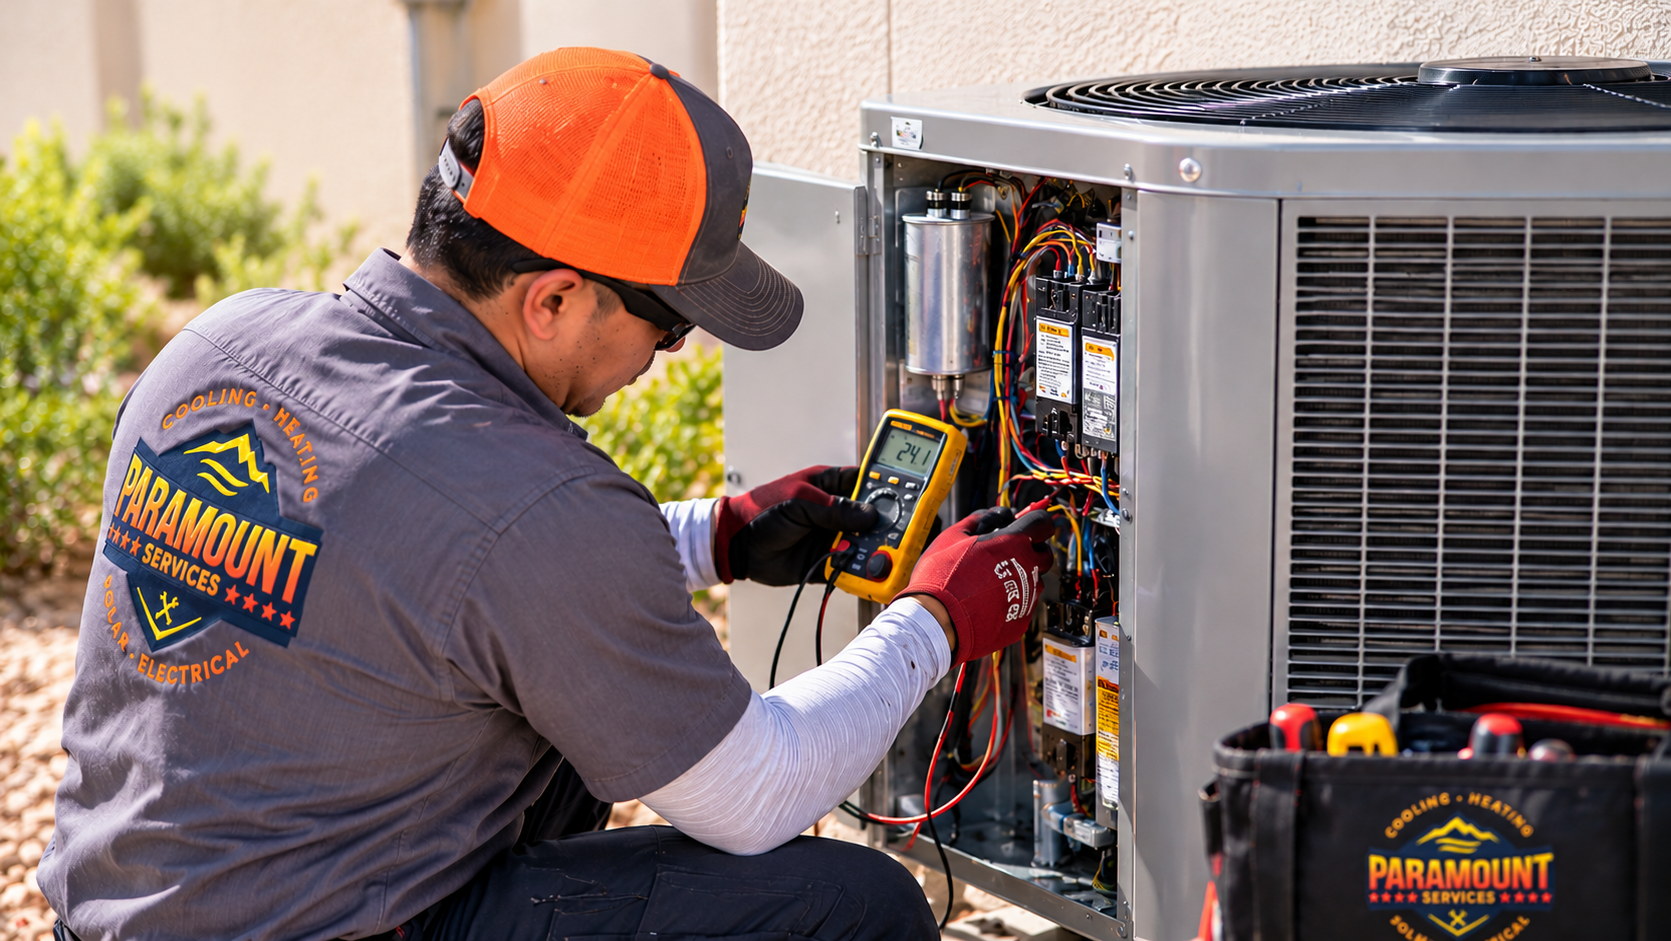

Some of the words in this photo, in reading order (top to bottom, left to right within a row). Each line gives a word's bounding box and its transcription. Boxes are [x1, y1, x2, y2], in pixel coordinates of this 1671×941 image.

[162, 388, 257, 430] COOLING
[272, 407, 319, 503] HEATING
[113, 453, 318, 604] PARAMOUNT
[142, 542, 221, 596] SERVICES
[137, 641, 250, 685] ELECTRICAL
[1384, 792, 1451, 839] COOLING
[1368, 852, 1554, 890] PARAMOUNT
[1421, 891, 1496, 905] SERVICES
